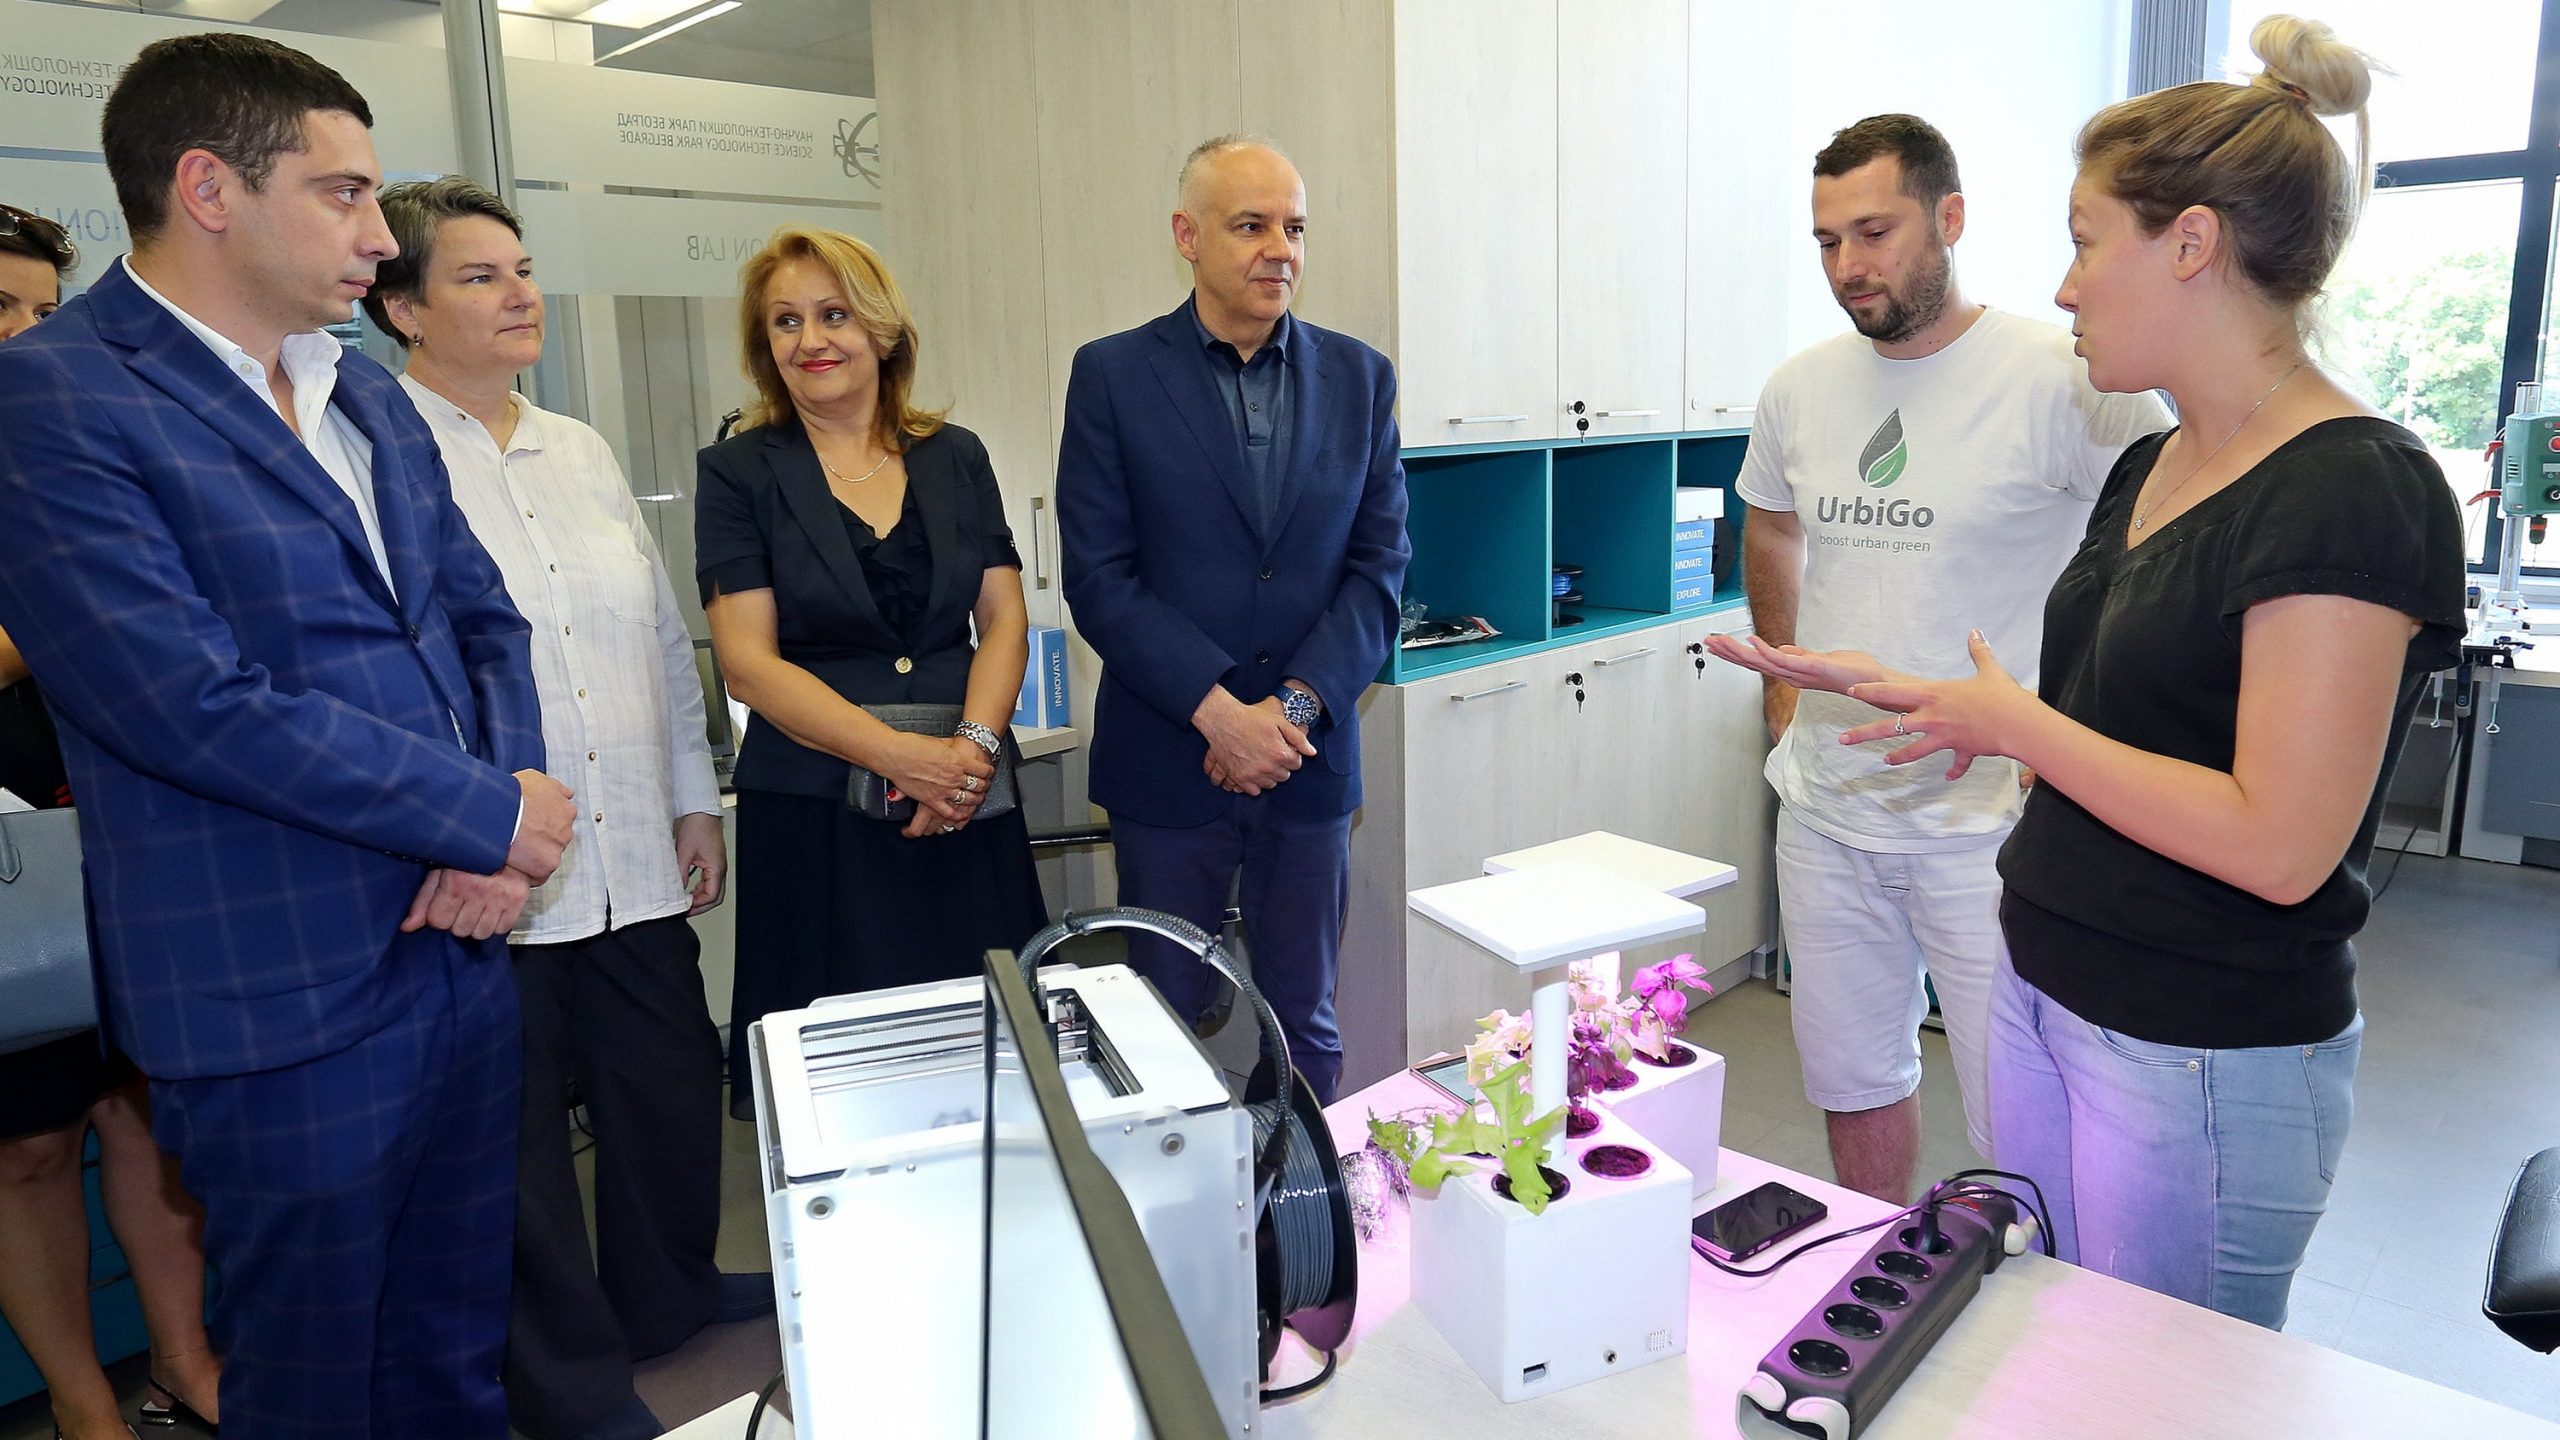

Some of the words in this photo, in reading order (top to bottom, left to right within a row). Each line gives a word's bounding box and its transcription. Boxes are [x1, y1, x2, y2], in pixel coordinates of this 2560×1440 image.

[1817, 496, 1935, 528] UrbiGo
[1819, 533, 1850, 547] boost
[1852, 536, 1889, 549] urban
[1892, 540, 1931, 553] green
[1674, 557, 1703, 571] NNOVATE
[1676, 586, 1702, 601] EXPLORE
